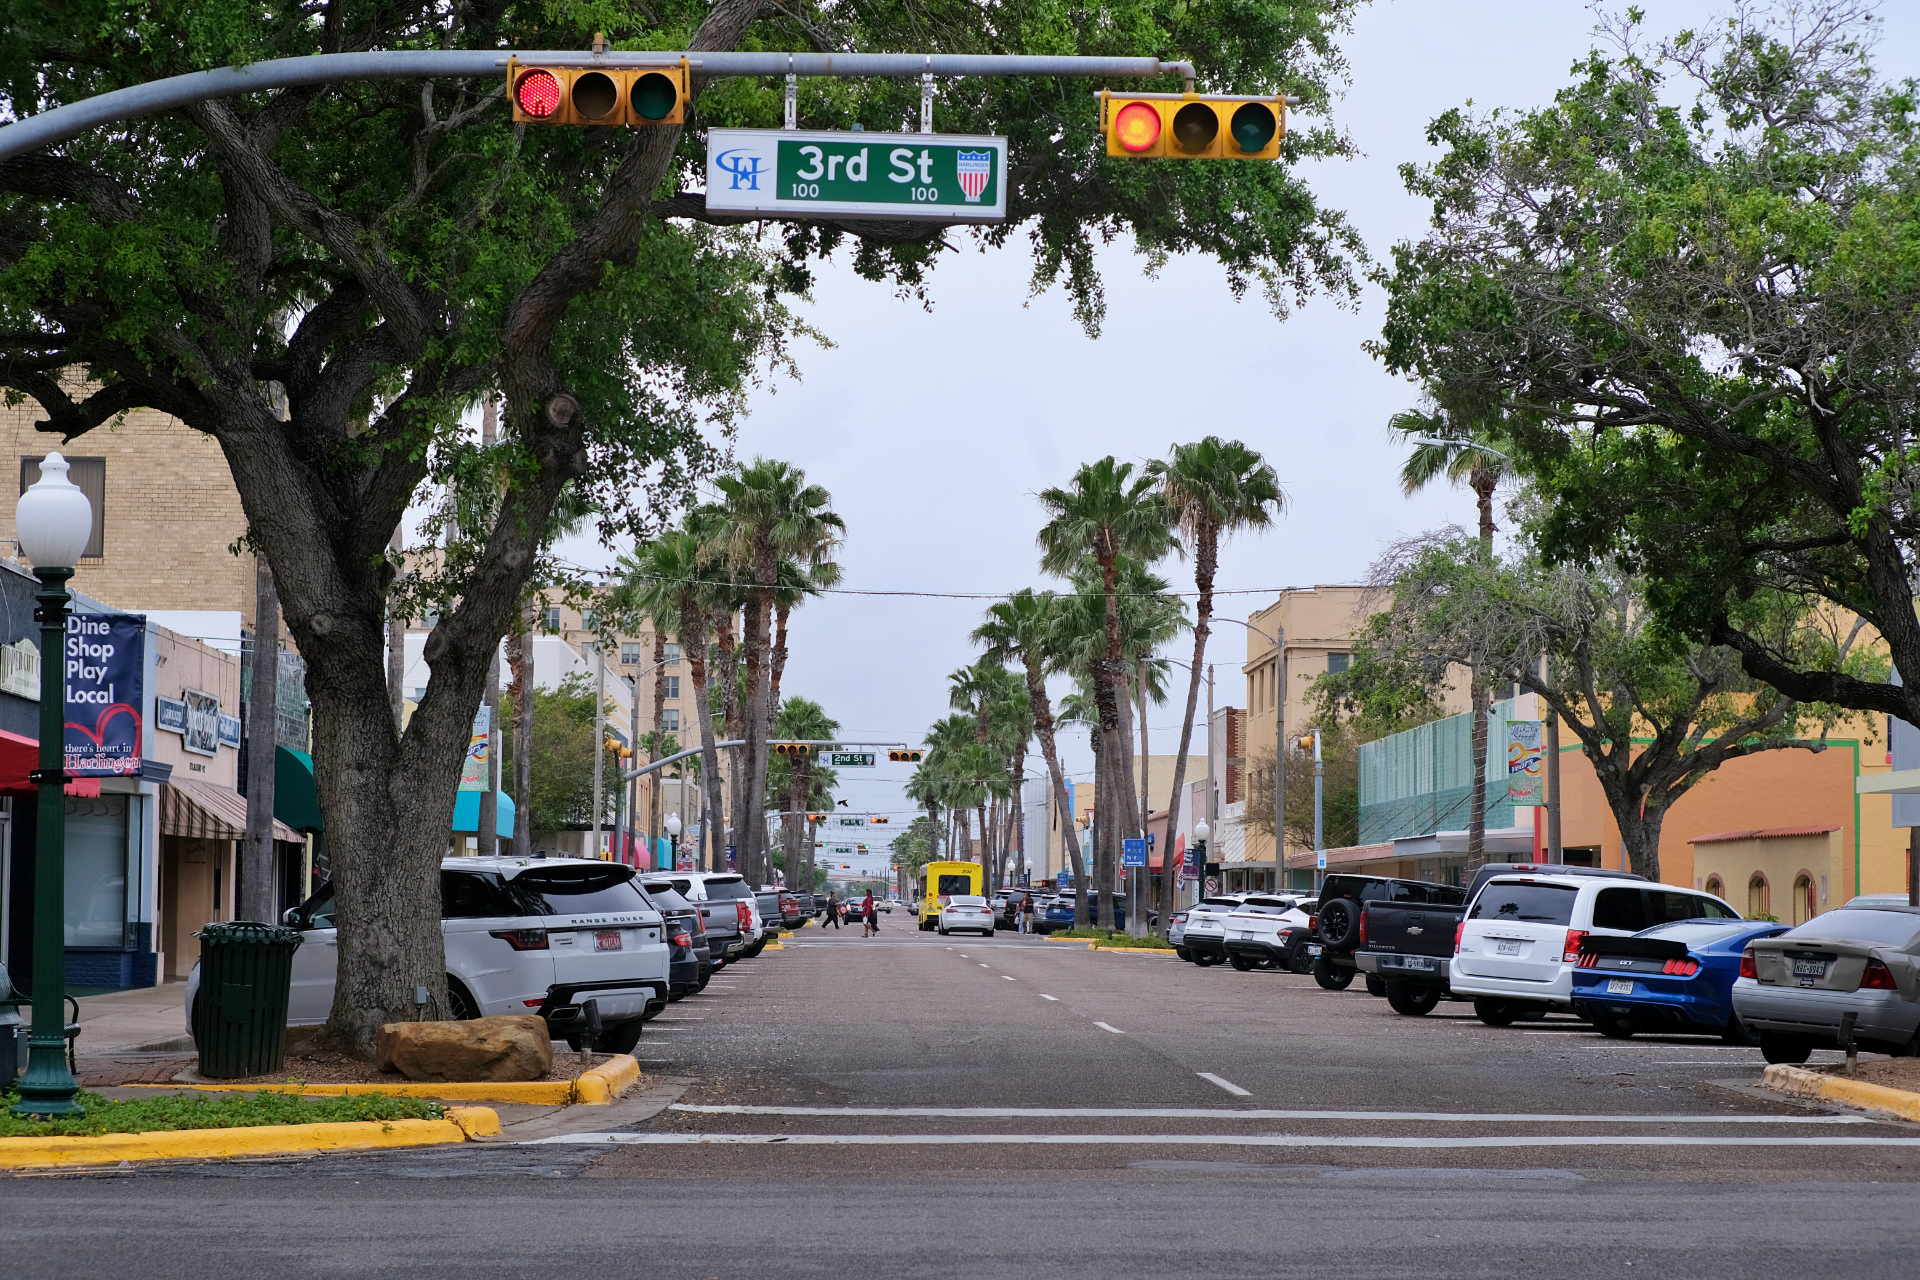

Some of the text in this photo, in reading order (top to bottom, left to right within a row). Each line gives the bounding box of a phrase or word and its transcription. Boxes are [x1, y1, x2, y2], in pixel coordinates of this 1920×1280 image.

[796, 145, 933, 185] 3rd St
[791, 183, 820, 199] 100
[910, 186, 939, 201] 100
[67, 615, 111, 636] Dine
[66, 636, 115, 663] Shop
[1, 645, 34, 684] UPPERCUT
[66, 658, 108, 685] Play
[66, 683, 115, 704] Local
[1510, 722, 1539, 735] Jackson
[1513, 733, 1537, 741] Street
[64, 742, 132, 753] there's heart in
[63, 752, 142, 774] Harlingen
[834, 754, 863, 762] 2nd St
[1510, 778, 1540, 786] MARKET
[1522, 786, 1540, 794] DAYS
